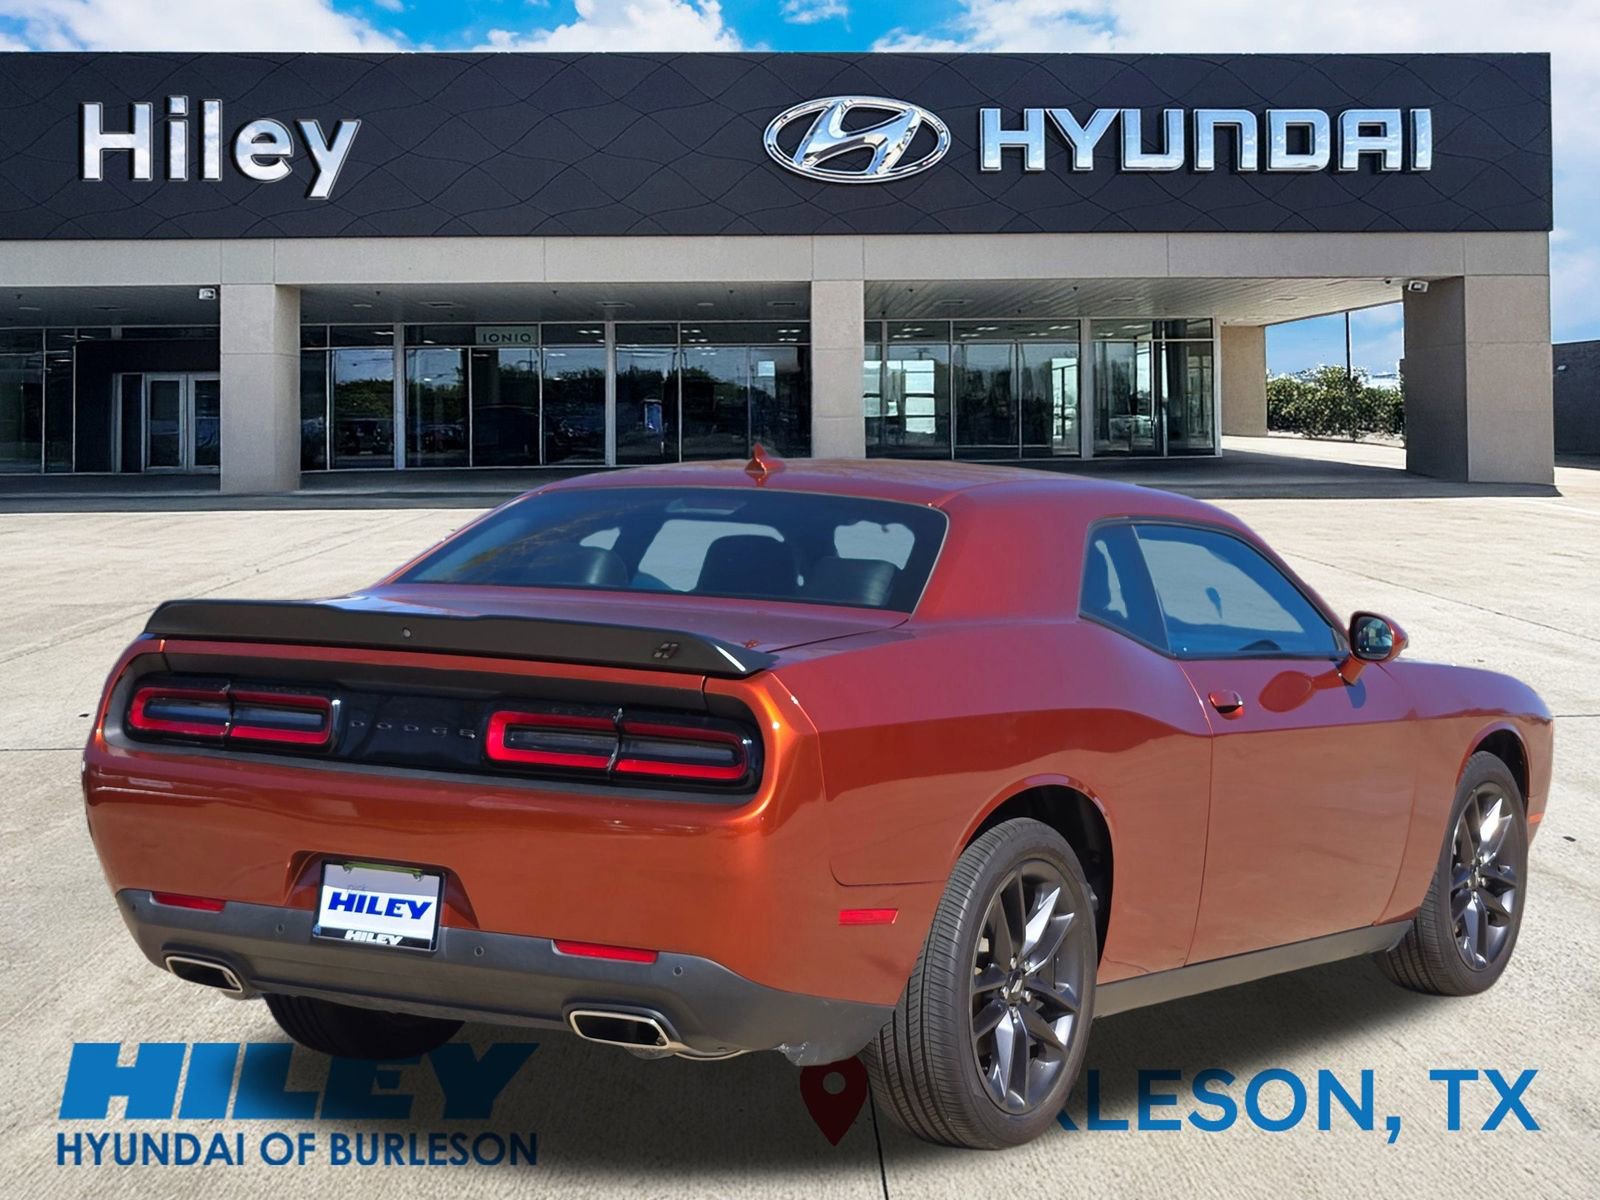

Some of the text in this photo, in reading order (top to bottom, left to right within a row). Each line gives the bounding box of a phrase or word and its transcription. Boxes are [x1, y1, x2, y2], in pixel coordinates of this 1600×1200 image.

[79, 95, 362, 199] Hiley
[979, 107, 1433, 172] HYUNDAI
[328, 891, 432, 920] HILEY
[344, 929, 403, 946] HILEY
